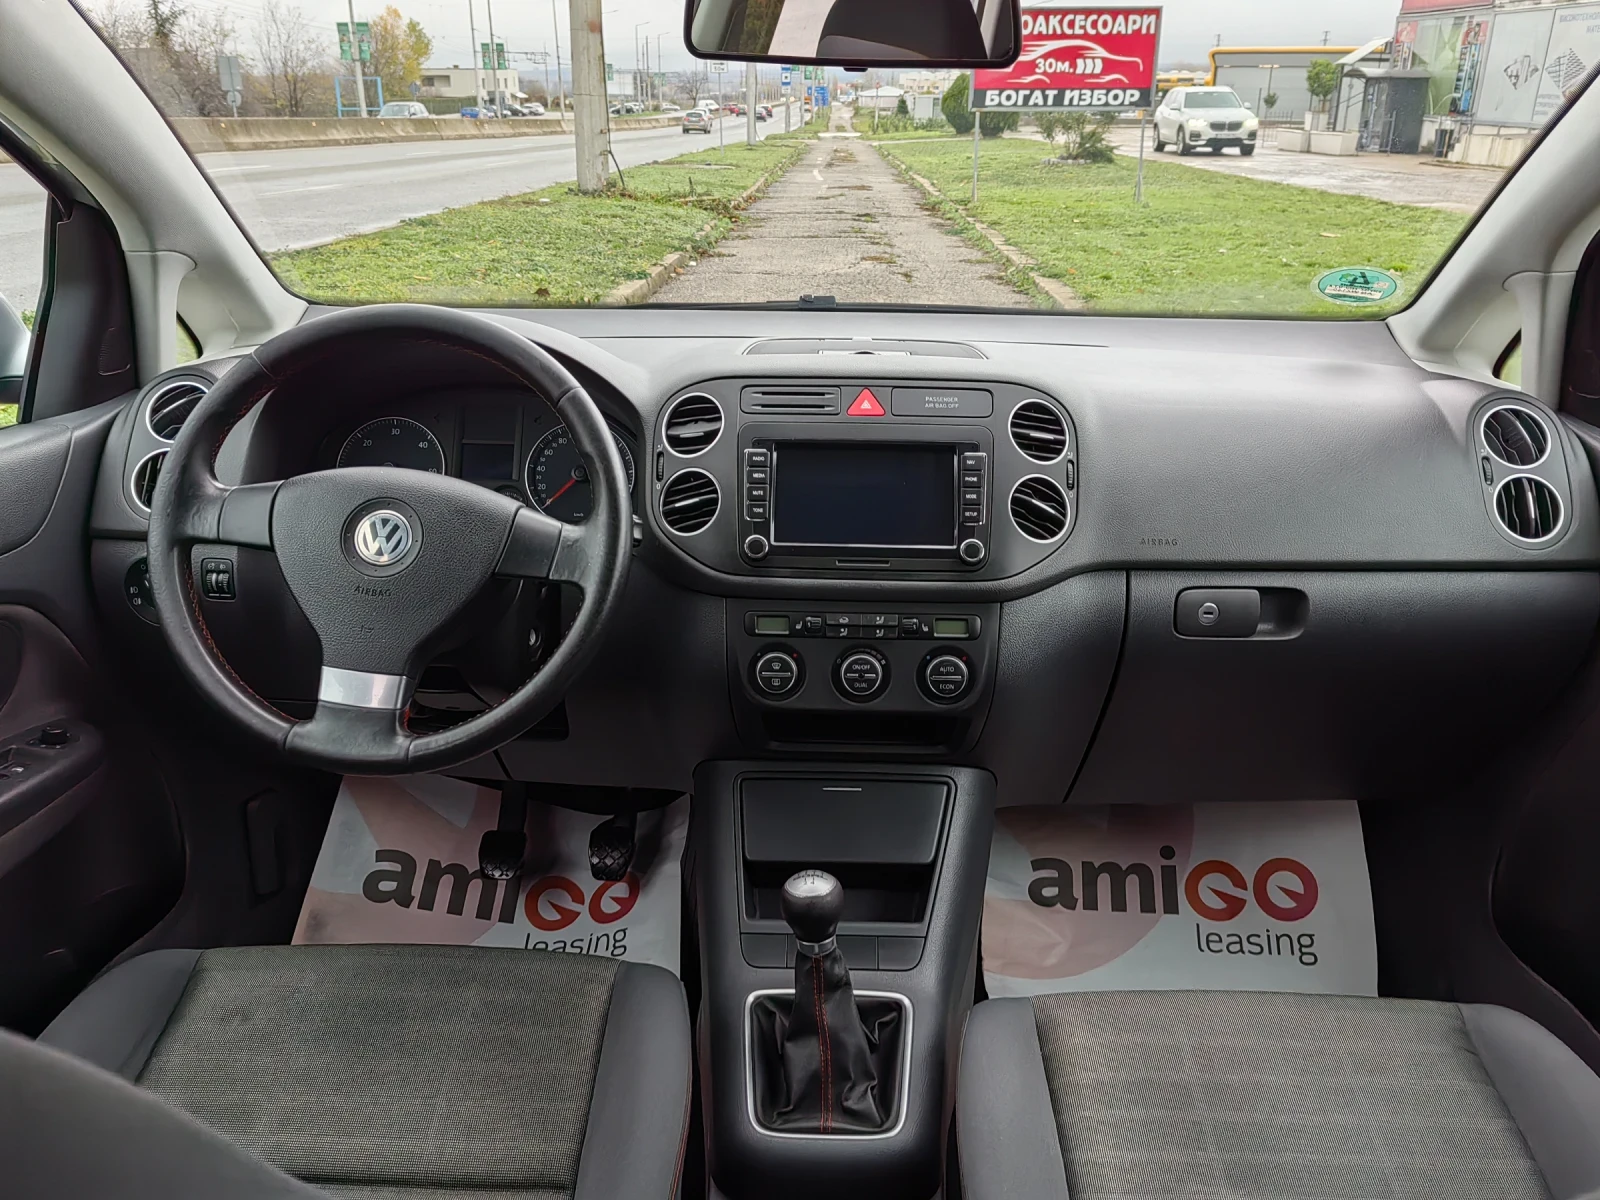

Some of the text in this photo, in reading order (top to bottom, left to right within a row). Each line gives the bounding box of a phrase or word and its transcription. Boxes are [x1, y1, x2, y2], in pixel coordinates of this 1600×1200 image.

[985, 89, 1141, 106] БОГАТ ИЗБОР
[363, 439, 372, 447] 20
[418, 441, 428, 449] 40
[1140, 538, 1178, 546] AIRBAG
[353, 585, 392, 597] AIRBAG
[1195, 922, 1319, 966] leasing
